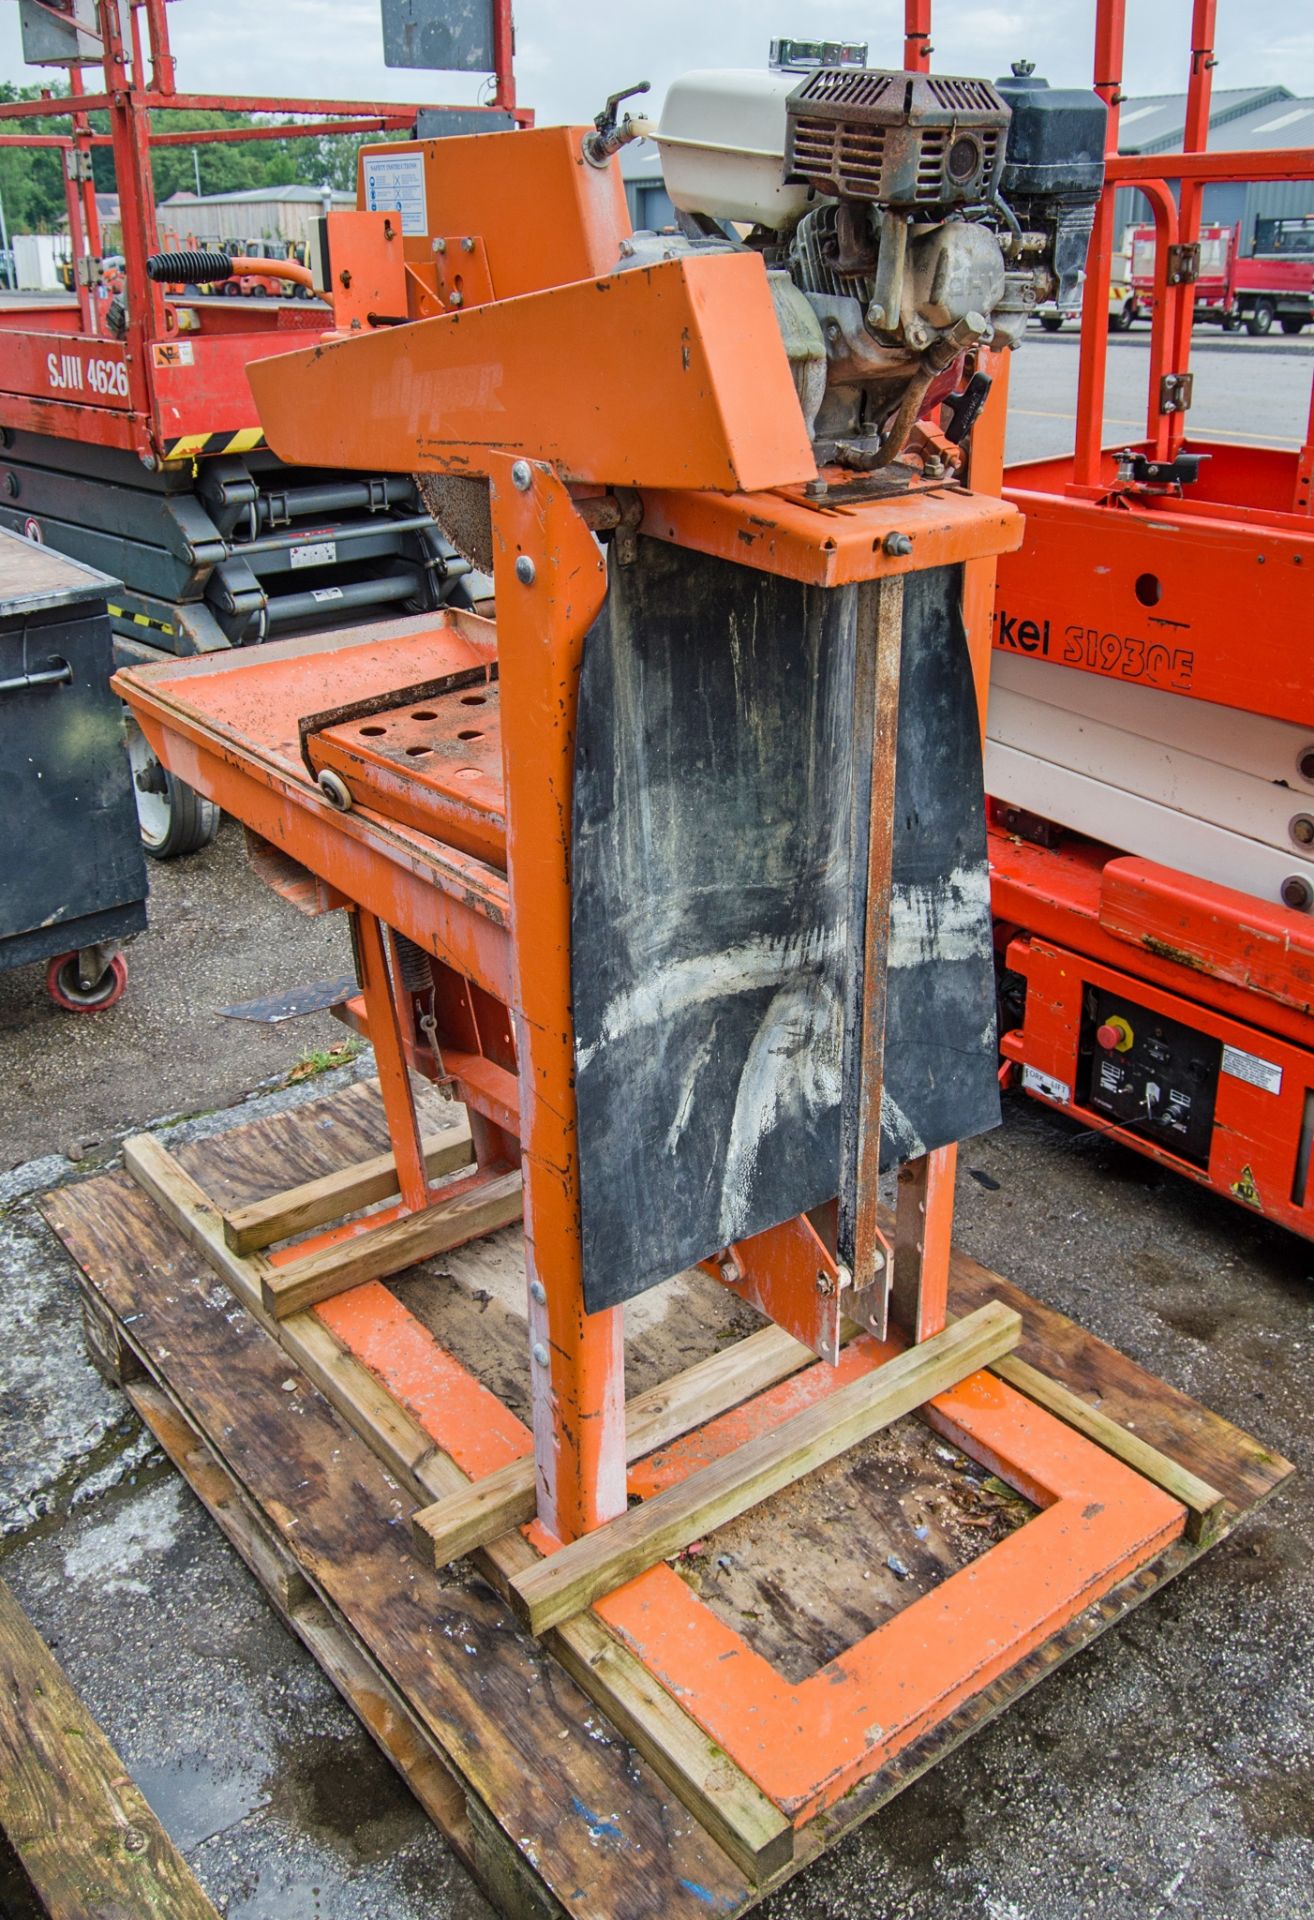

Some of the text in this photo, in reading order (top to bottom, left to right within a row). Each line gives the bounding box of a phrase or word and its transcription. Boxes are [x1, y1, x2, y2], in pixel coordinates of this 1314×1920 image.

[87, 358, 129, 397] 4626
[1063, 625, 1194, 690] S1930E
[1025, 1067, 1067, 1094] FORK LIFT
